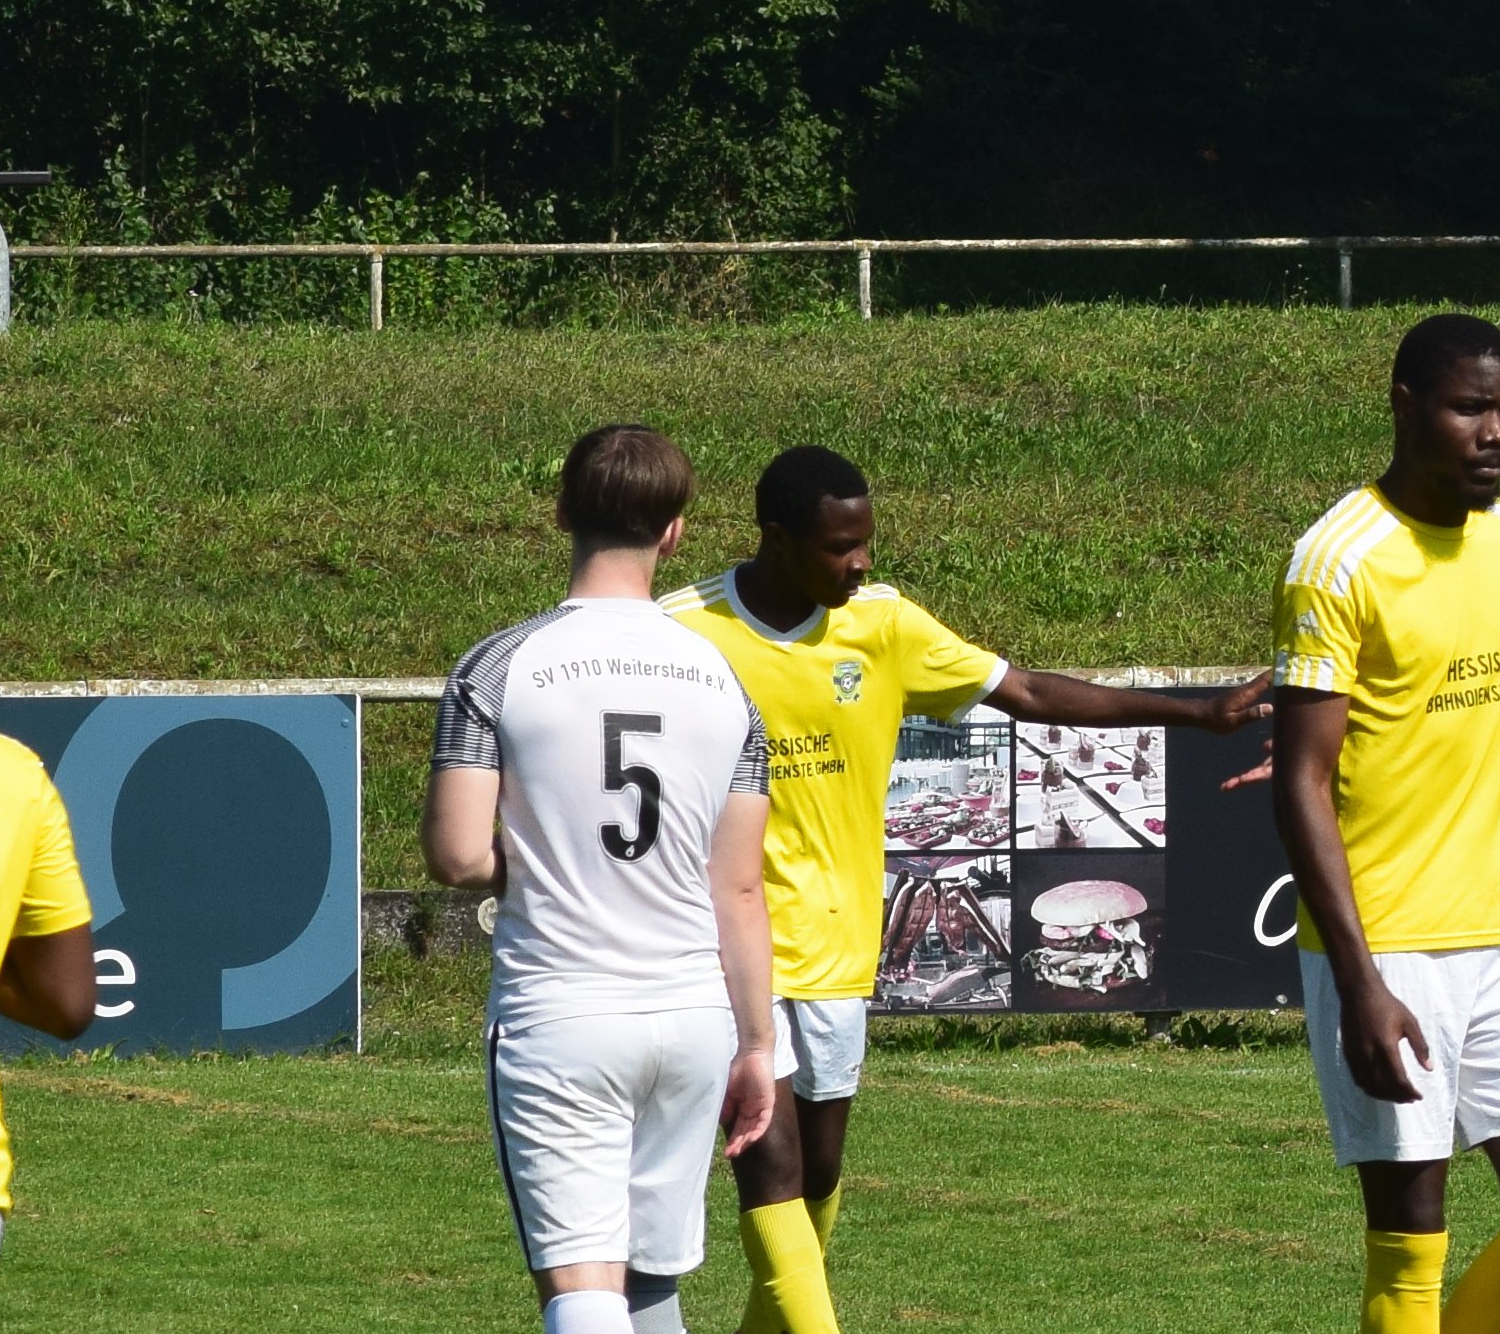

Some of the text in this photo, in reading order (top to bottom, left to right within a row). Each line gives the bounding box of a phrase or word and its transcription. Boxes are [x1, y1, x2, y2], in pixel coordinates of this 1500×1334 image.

[532, 658, 727, 694] SV 1910 Weiterstadt e.V.
[767, 733, 831, 757] SSISCHE
[770, 759, 846, 781] IENSTE GMBH
[598, 710, 664, 863] 5
